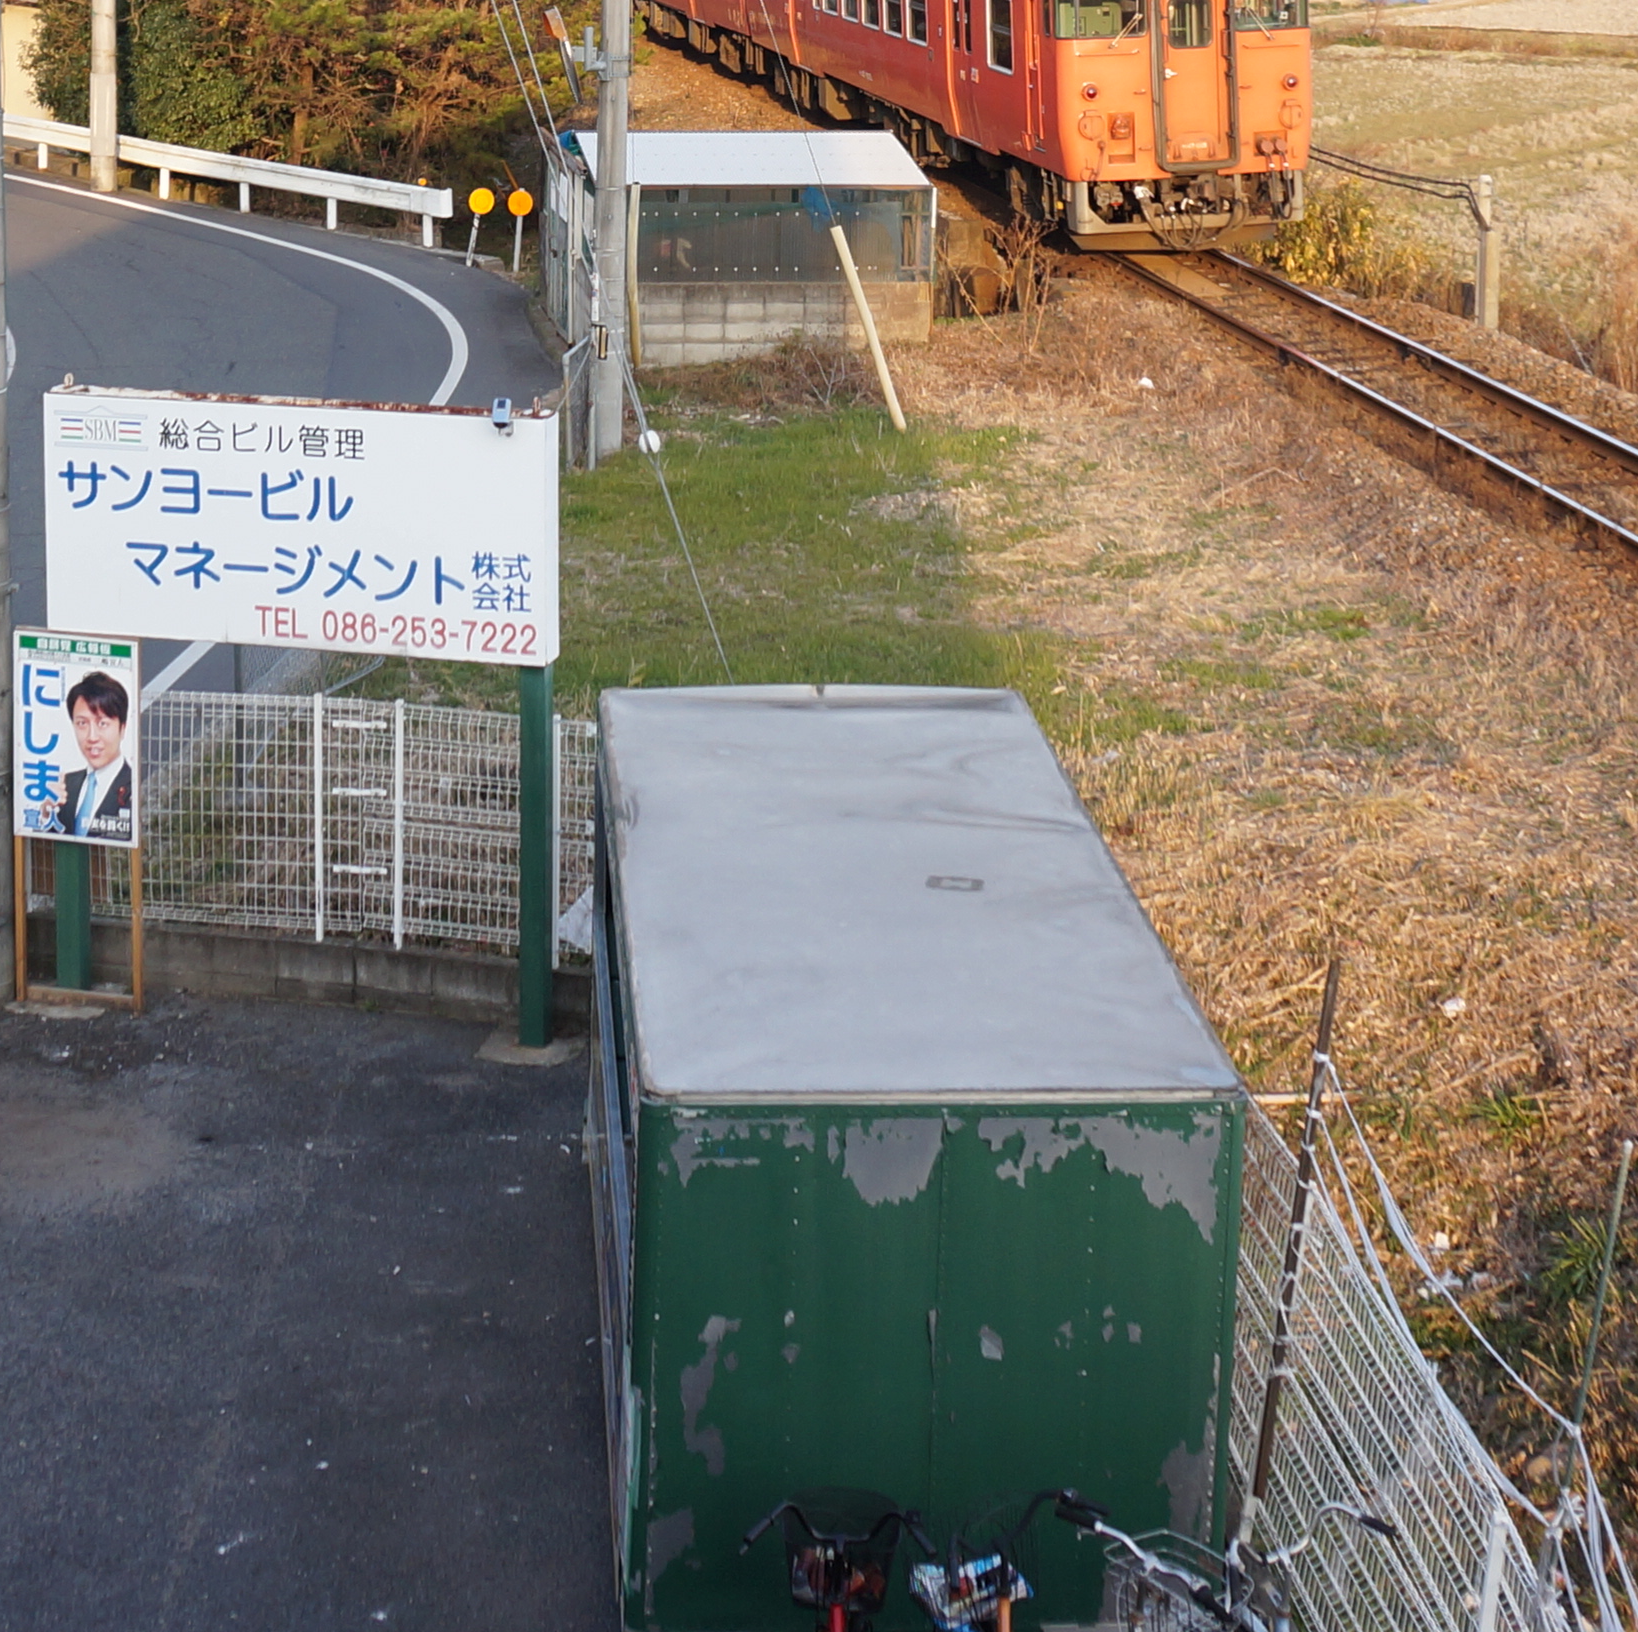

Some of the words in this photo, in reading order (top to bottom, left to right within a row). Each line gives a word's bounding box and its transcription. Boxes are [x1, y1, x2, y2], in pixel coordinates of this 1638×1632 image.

[83, 418, 119, 443] SBM
[158, 417, 366, 461] 総合ビル管理
[57, 459, 355, 522] サンヨービル
[125, 540, 465, 605] マネージメント
[254, 605, 309, 639] TEL
[321, 609, 538, 656] 086-253-7222
[21, 663, 61, 802] にしま
